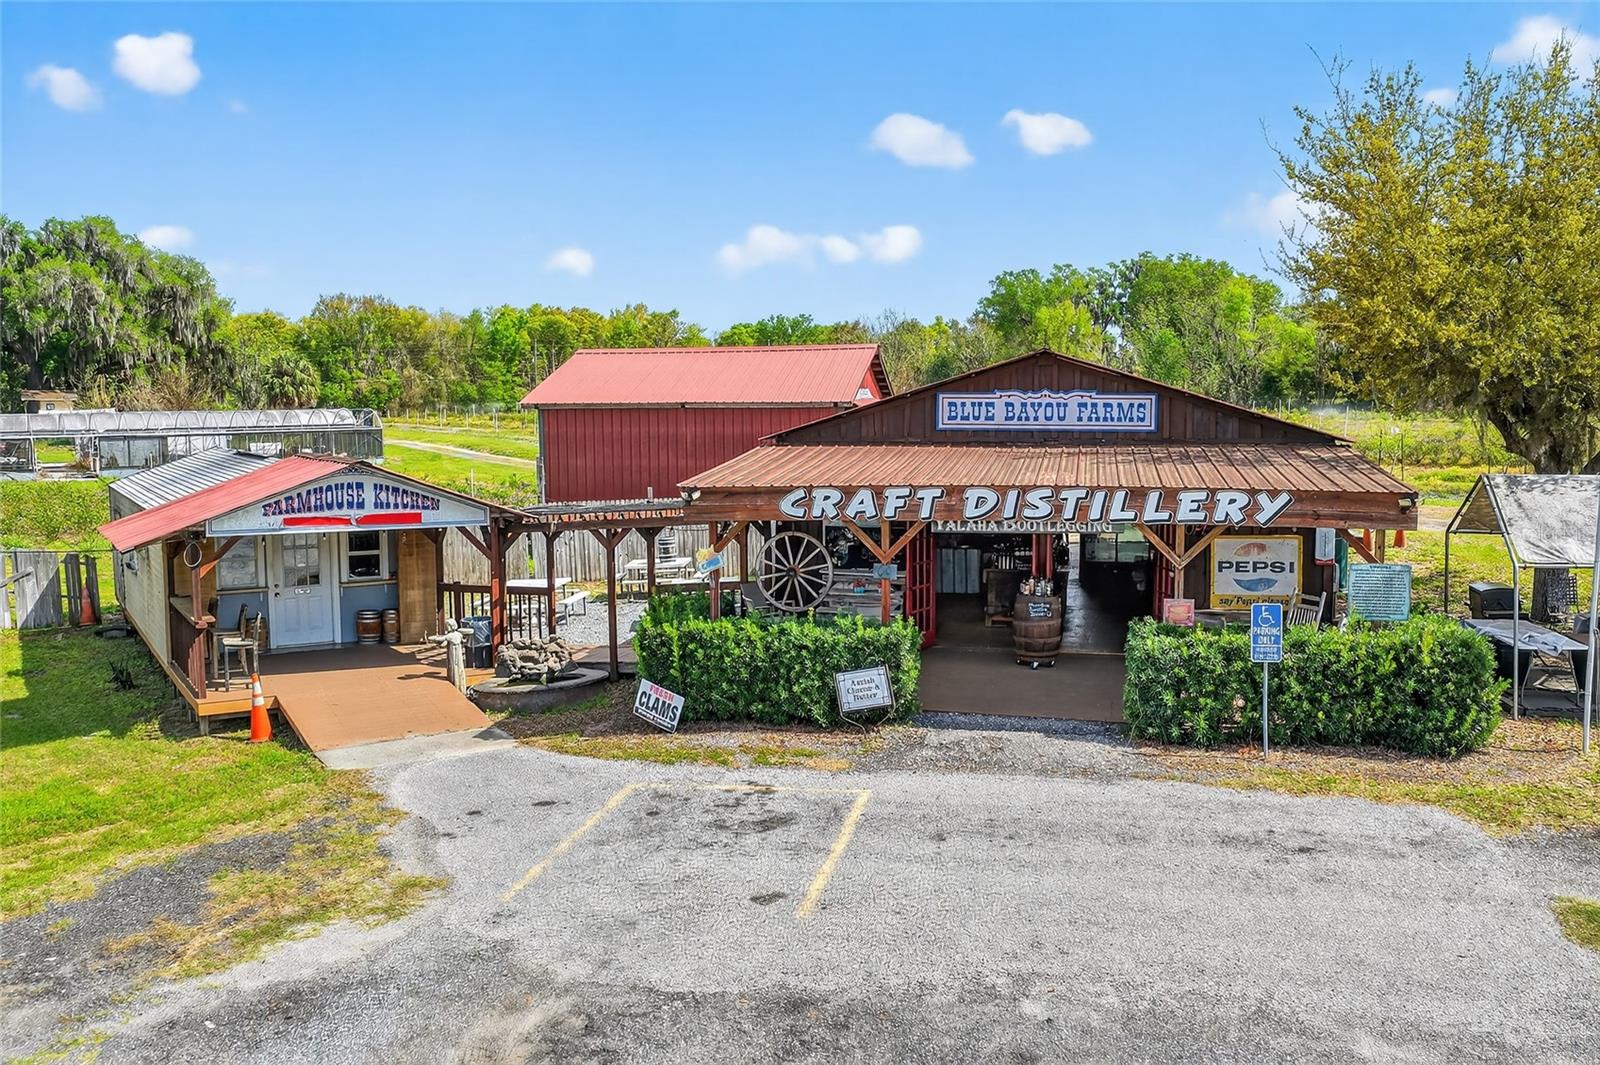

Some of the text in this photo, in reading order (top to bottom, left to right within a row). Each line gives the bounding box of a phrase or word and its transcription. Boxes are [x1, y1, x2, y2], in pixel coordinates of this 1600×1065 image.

[947, 401, 1147, 423] BLUE BAYOU FARMS
[261, 481, 441, 517] FARMHOUSE KITCHEN
[779, 486, 1295, 528] CRAFT DISTILLERY
[936, 520, 1113, 533] YALAHA BOOTLEGGING
[1217, 560, 1295, 573] PEPSI
[1253, 626, 1281, 636] PARKING
[638, 691, 679, 722] CLAMS
